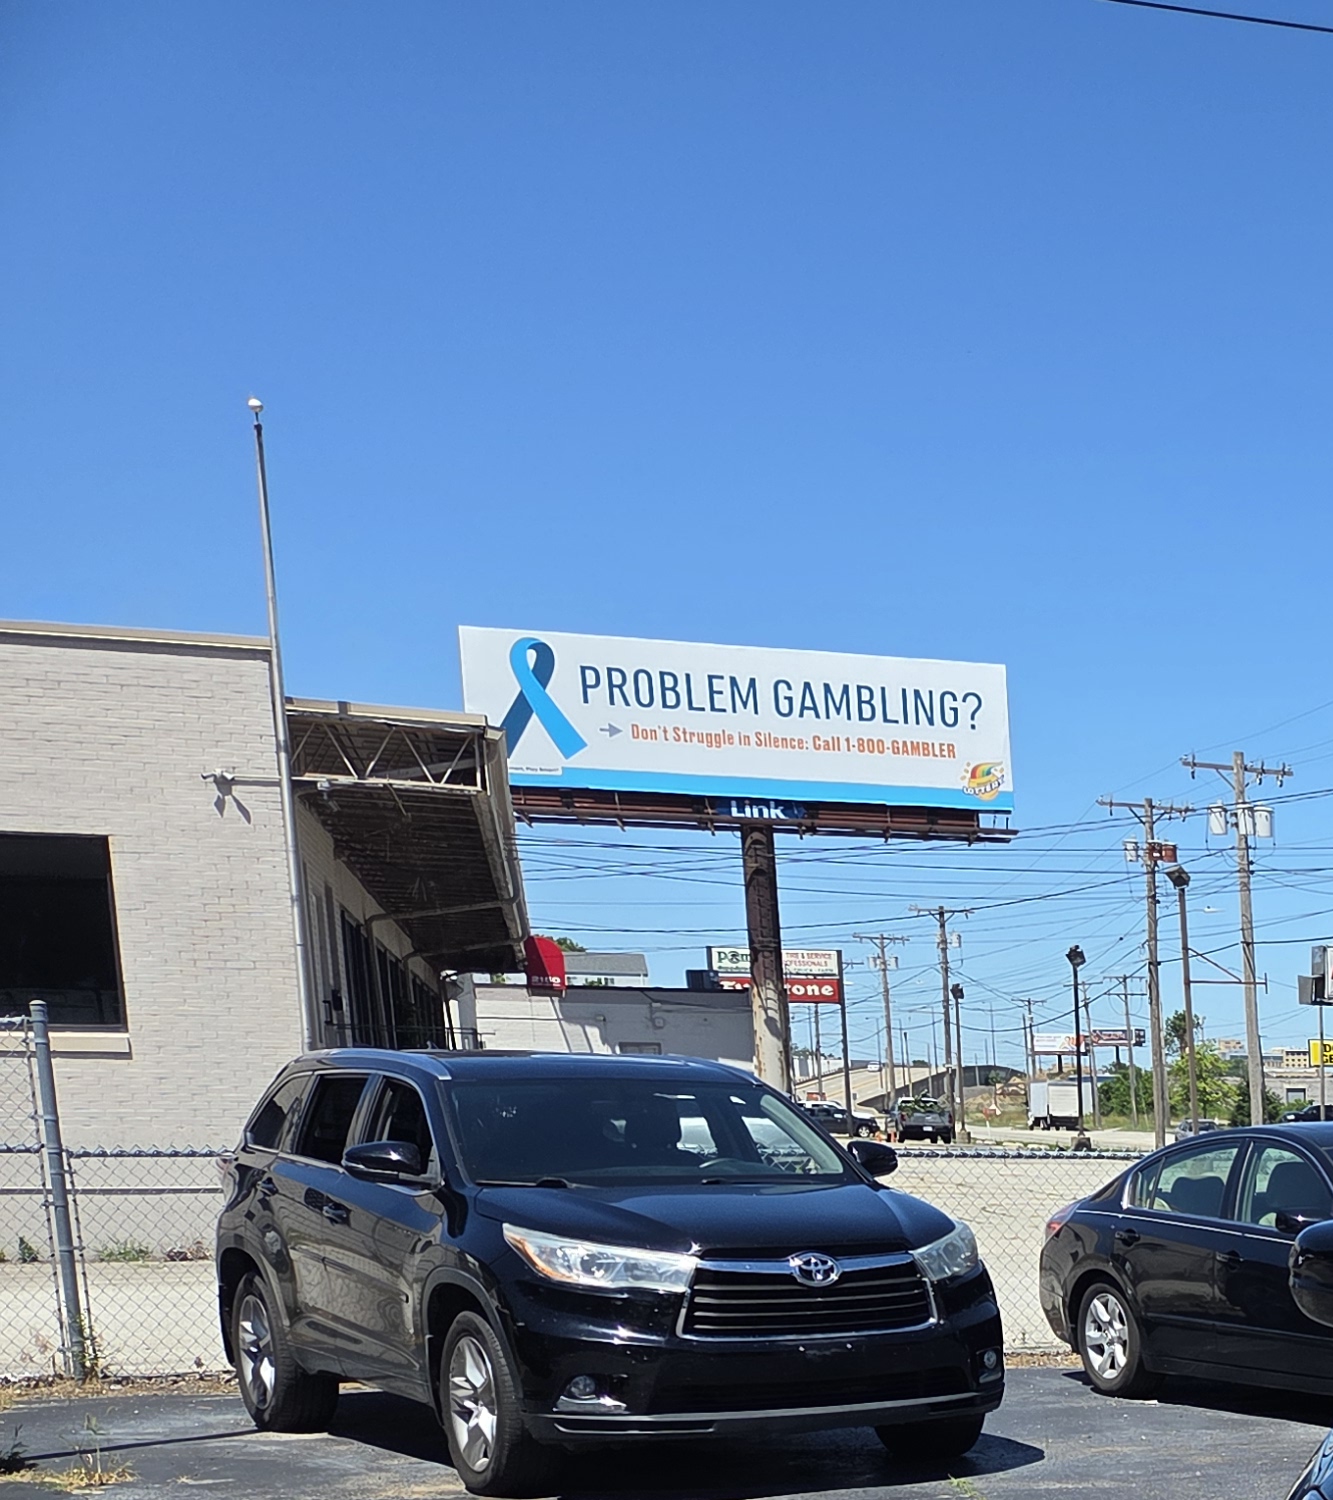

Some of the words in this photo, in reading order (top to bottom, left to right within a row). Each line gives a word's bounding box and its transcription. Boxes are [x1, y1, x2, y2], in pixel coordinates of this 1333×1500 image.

[579, 665, 760, 716] PROBLEM
[772, 678, 983, 731] GAMBLING?
[631, 723, 669, 742] Don't
[672, 726, 735, 749] Struggle
[738, 731, 751, 747] in
[754, 731, 809, 751] Silence:
[812, 734, 841, 752] Call
[844, 736, 957, 760] 1-800-GAMBLER
[730, 800, 790, 819] Link
